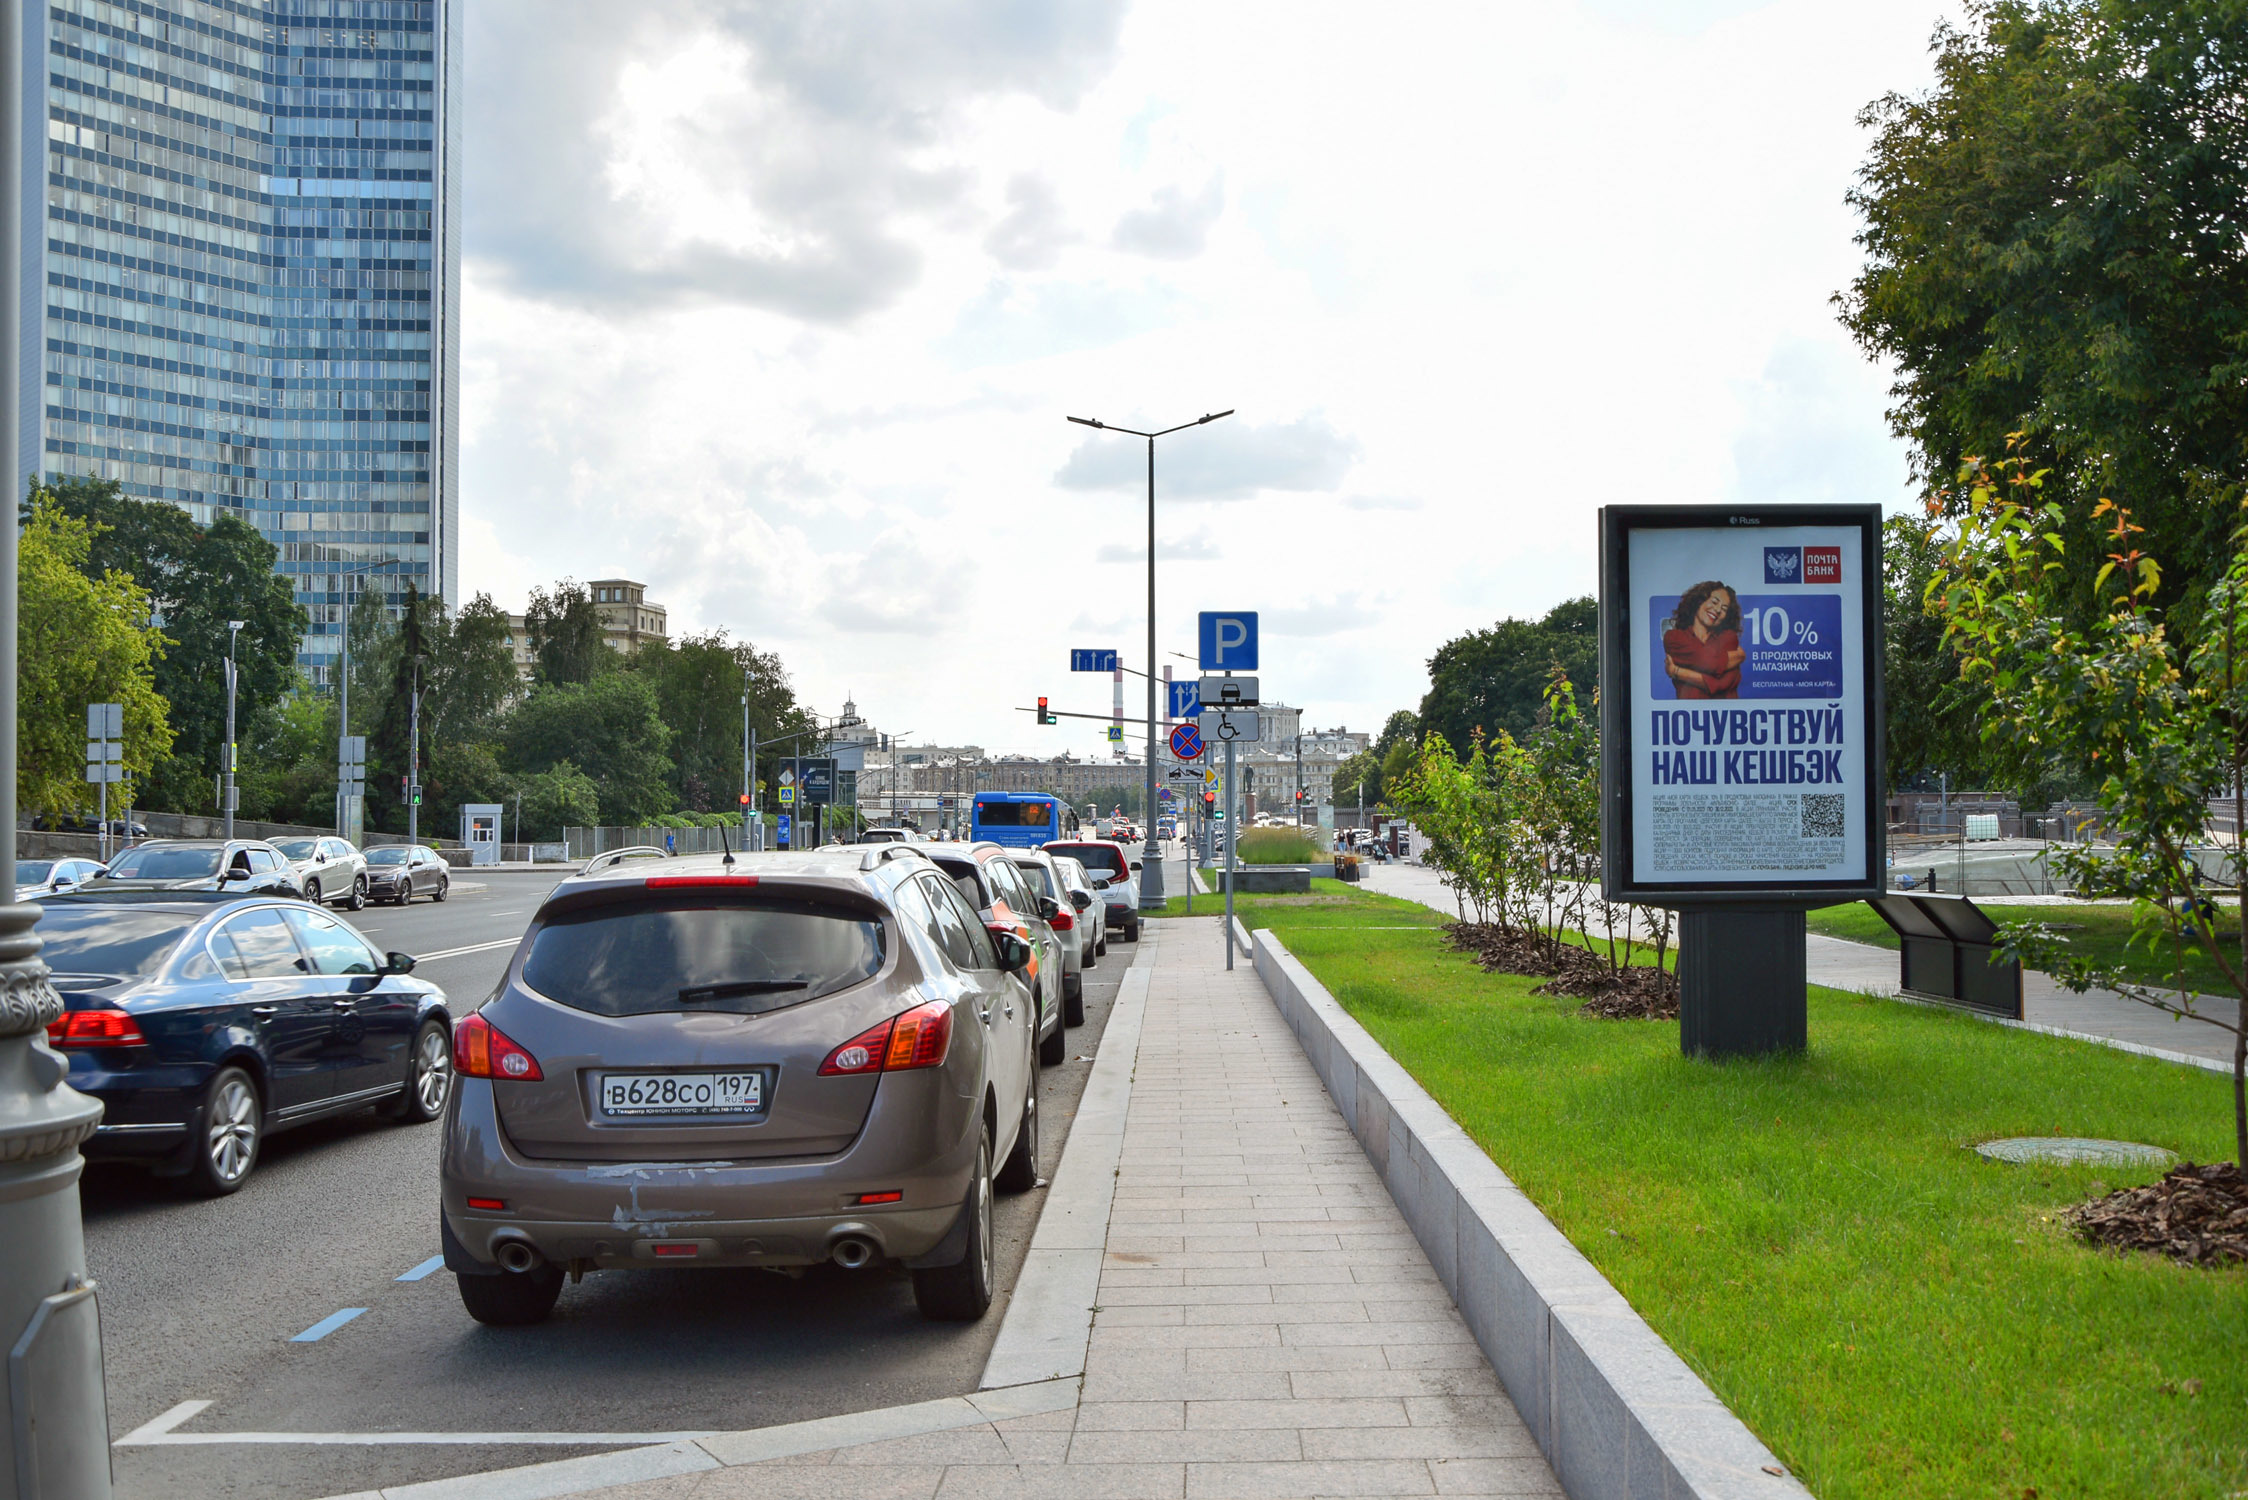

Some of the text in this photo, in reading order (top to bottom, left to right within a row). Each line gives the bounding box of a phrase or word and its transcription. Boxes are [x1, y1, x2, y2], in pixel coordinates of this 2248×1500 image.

[1739, 516, 1760, 525] Russ
[1807, 554, 1838, 565] ПОЧТА
[1807, 566, 1835, 577] БАНК
[1215, 619, 1247, 664] P
[1752, 650, 1833, 661] В ПРОДУКТОВЫХ
[1752, 662, 1809, 672] МАГАЗИНАХ
[1651, 703, 1844, 746] ПОЧУВСТВУЙ
[1652, 750, 1844, 785] НАШ КЕШБЭК
[717, 1076, 754, 1096] 197
[725, 1096, 743, 1104] RUS
